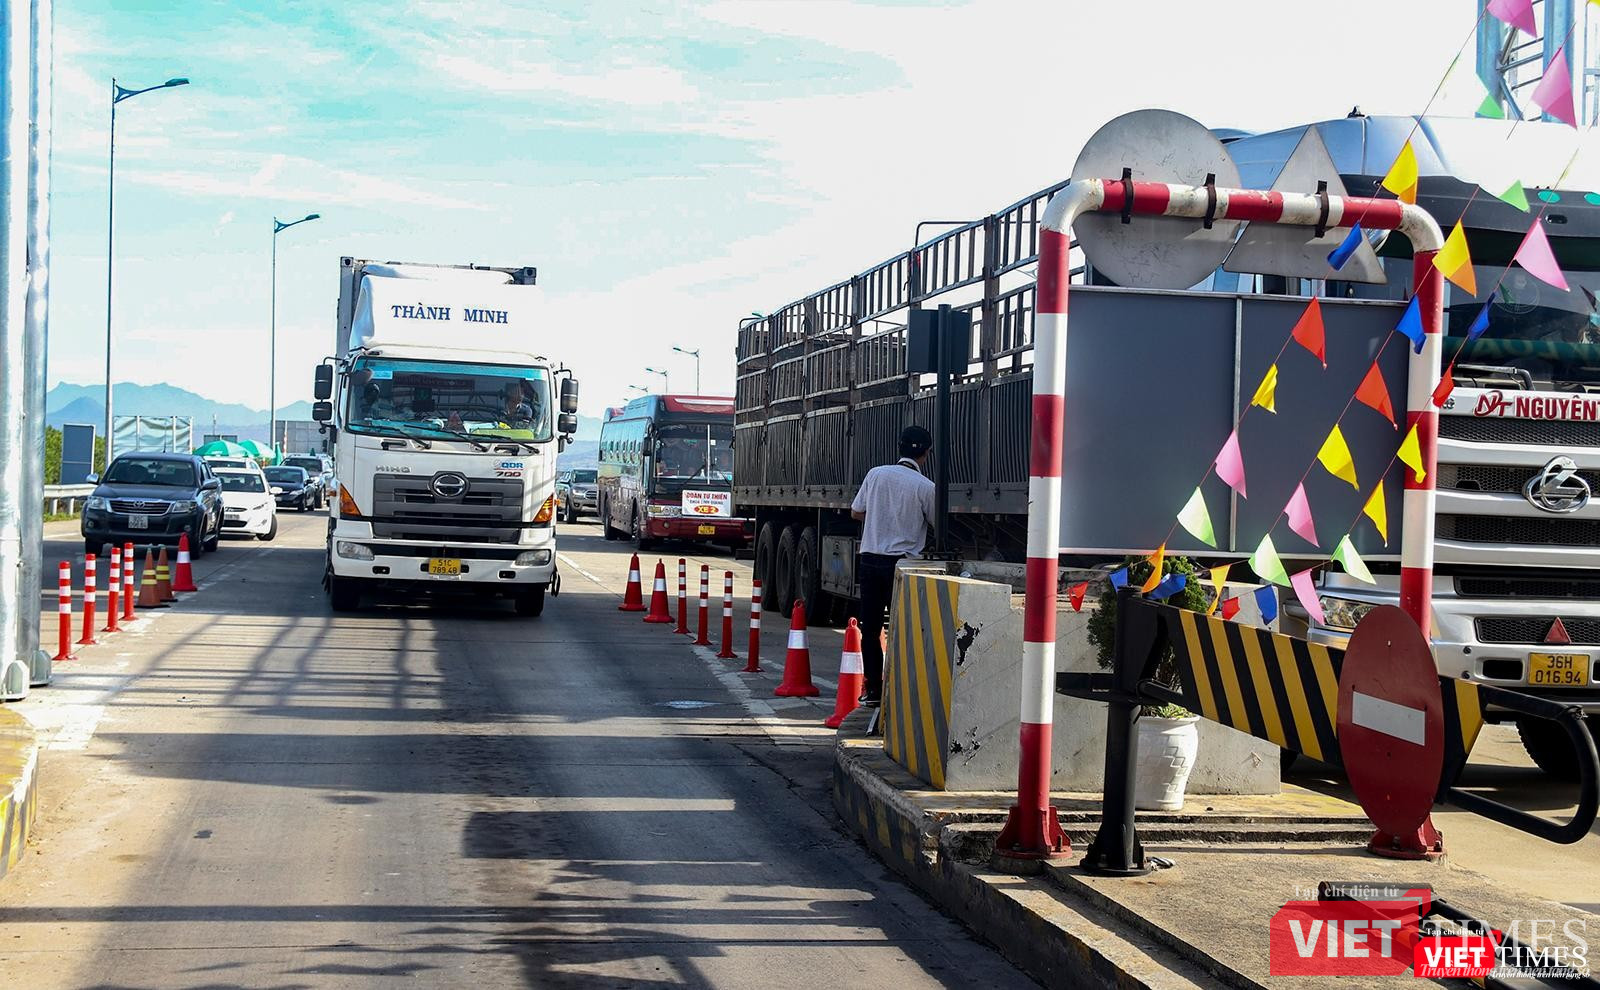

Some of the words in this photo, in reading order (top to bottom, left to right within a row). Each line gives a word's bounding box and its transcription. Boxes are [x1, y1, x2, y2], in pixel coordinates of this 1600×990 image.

[391, 302, 451, 320] THÀNH
[464, 308, 508, 324] MINH
[438, 559, 453, 567] 51C
[1547, 655, 1573, 669] 36H
[1535, 670, 1581, 684] 016.94
